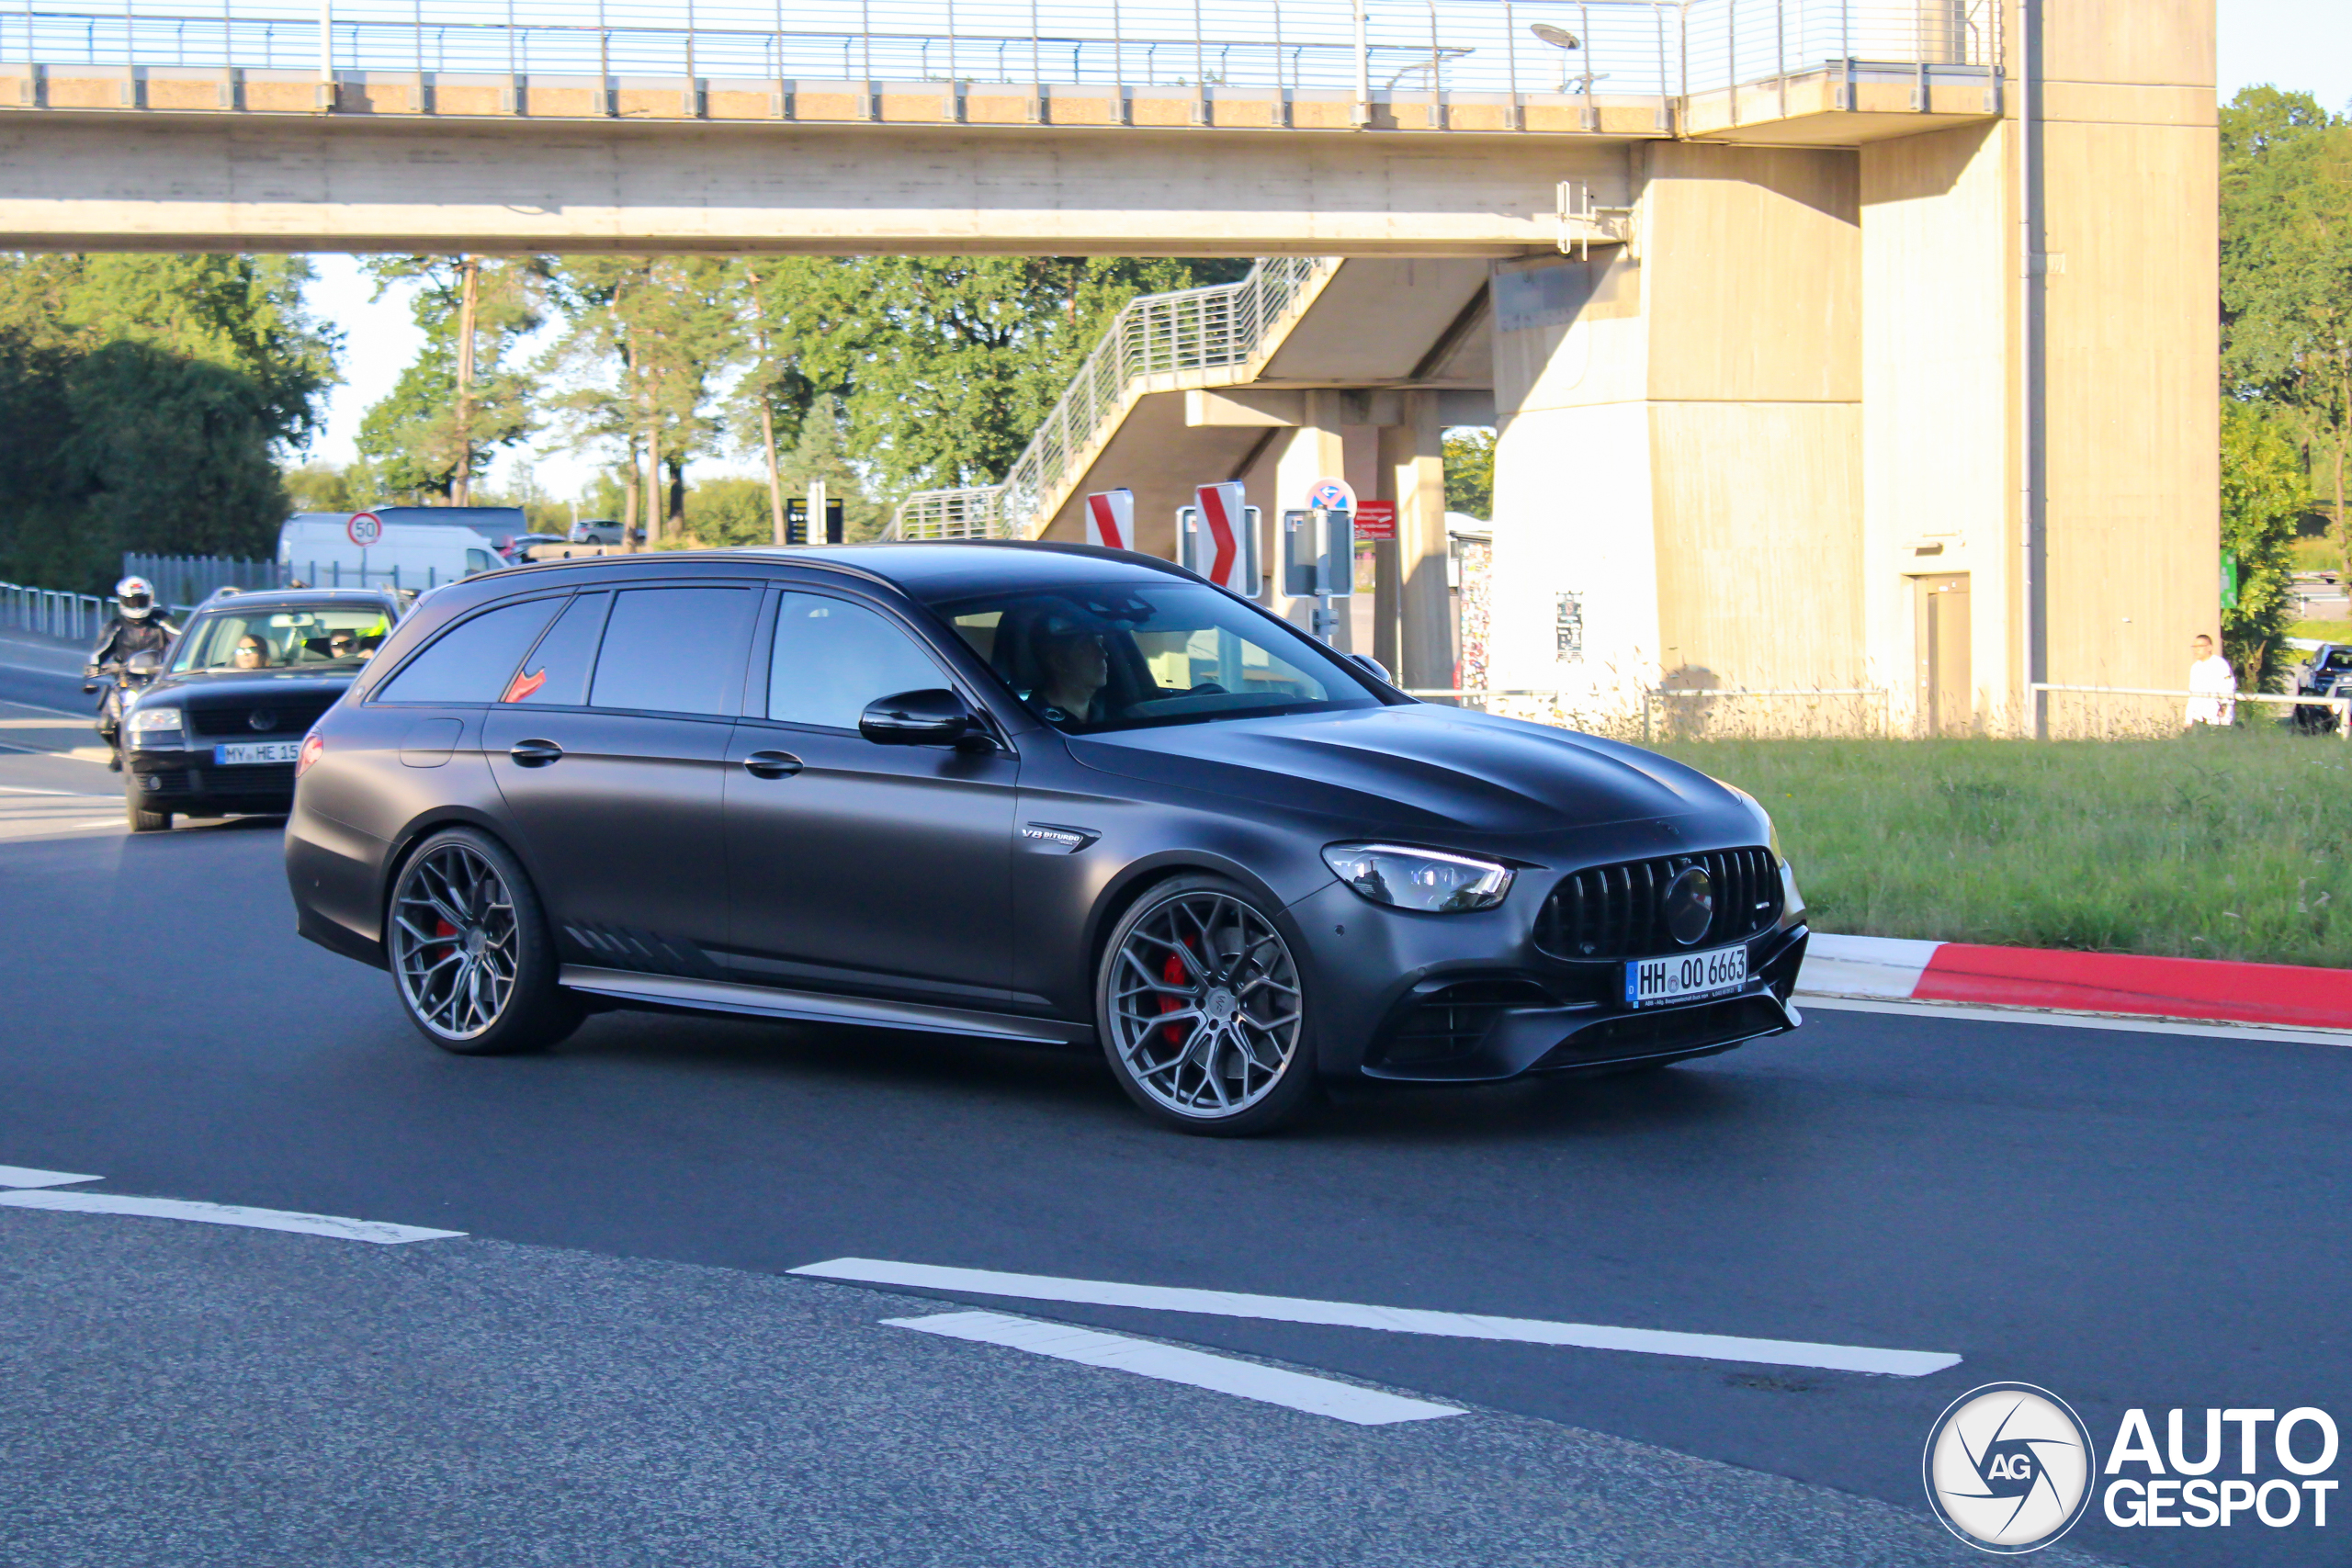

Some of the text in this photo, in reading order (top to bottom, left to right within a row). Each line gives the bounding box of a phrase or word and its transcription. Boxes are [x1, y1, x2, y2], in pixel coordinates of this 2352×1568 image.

[356, 522, 375, 537] 50
[226, 744, 299, 761] MY HE 15
[1022, 829, 1080, 842] V8 BITURBO
[1640, 949, 1746, 995] HH OO 6663
[1628, 986, 1634, 995] D
